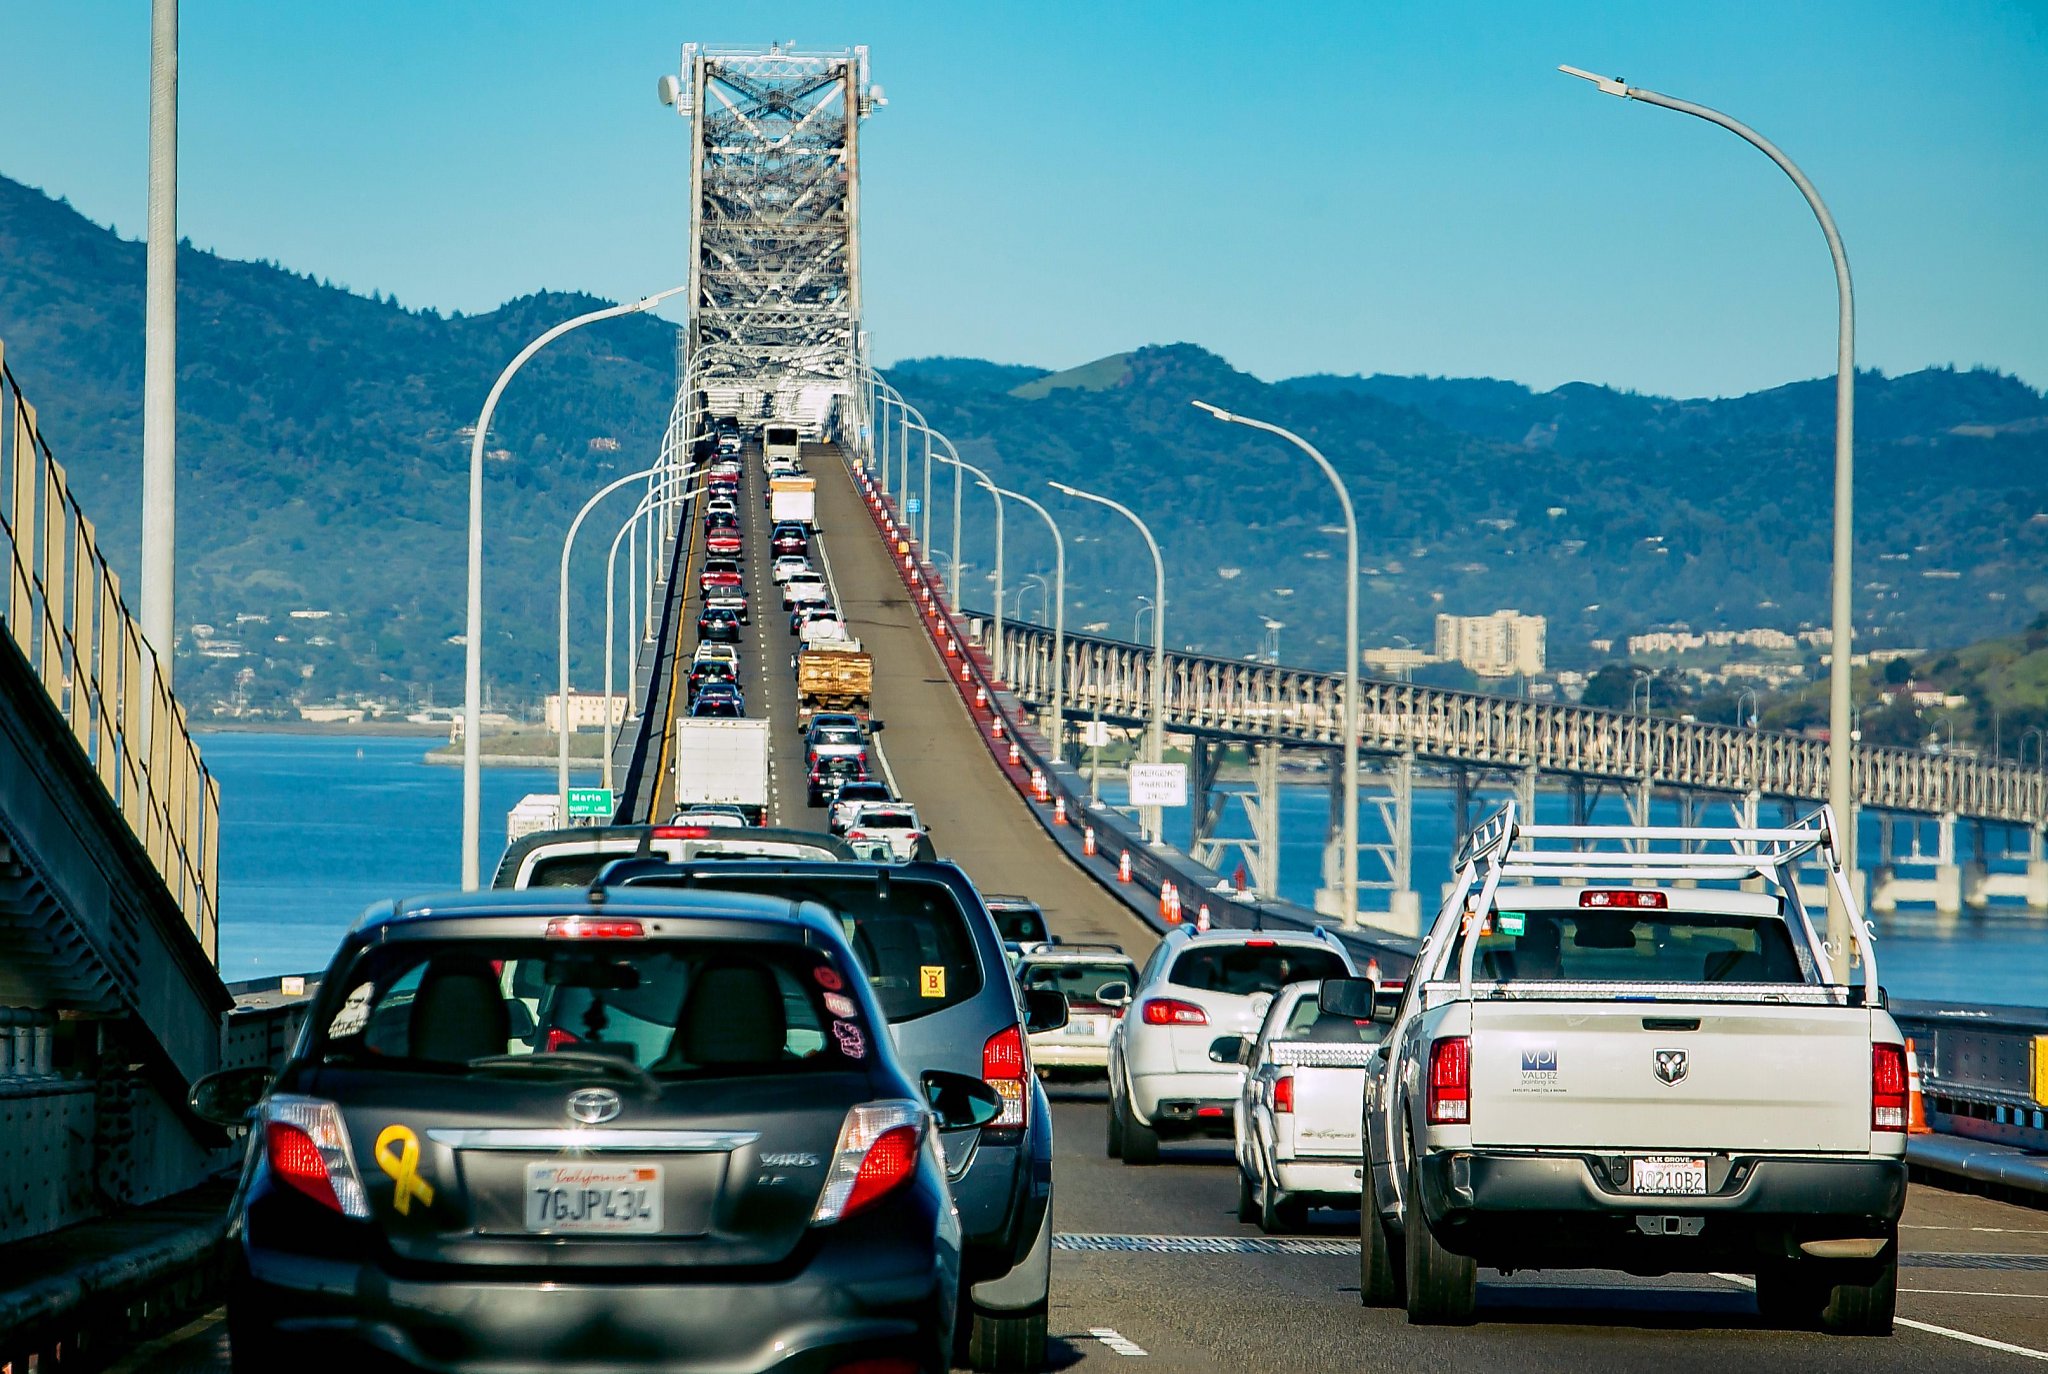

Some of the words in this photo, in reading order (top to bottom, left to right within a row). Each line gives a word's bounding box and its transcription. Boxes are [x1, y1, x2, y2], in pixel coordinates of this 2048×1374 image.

[571, 793, 602, 801] Marin
[929, 975, 938, 989] B
[1521, 1071, 1558, 1080] VALDEZ
[554, 1168, 628, 1188] California
[534, 1188, 652, 1220] 7GJP434
